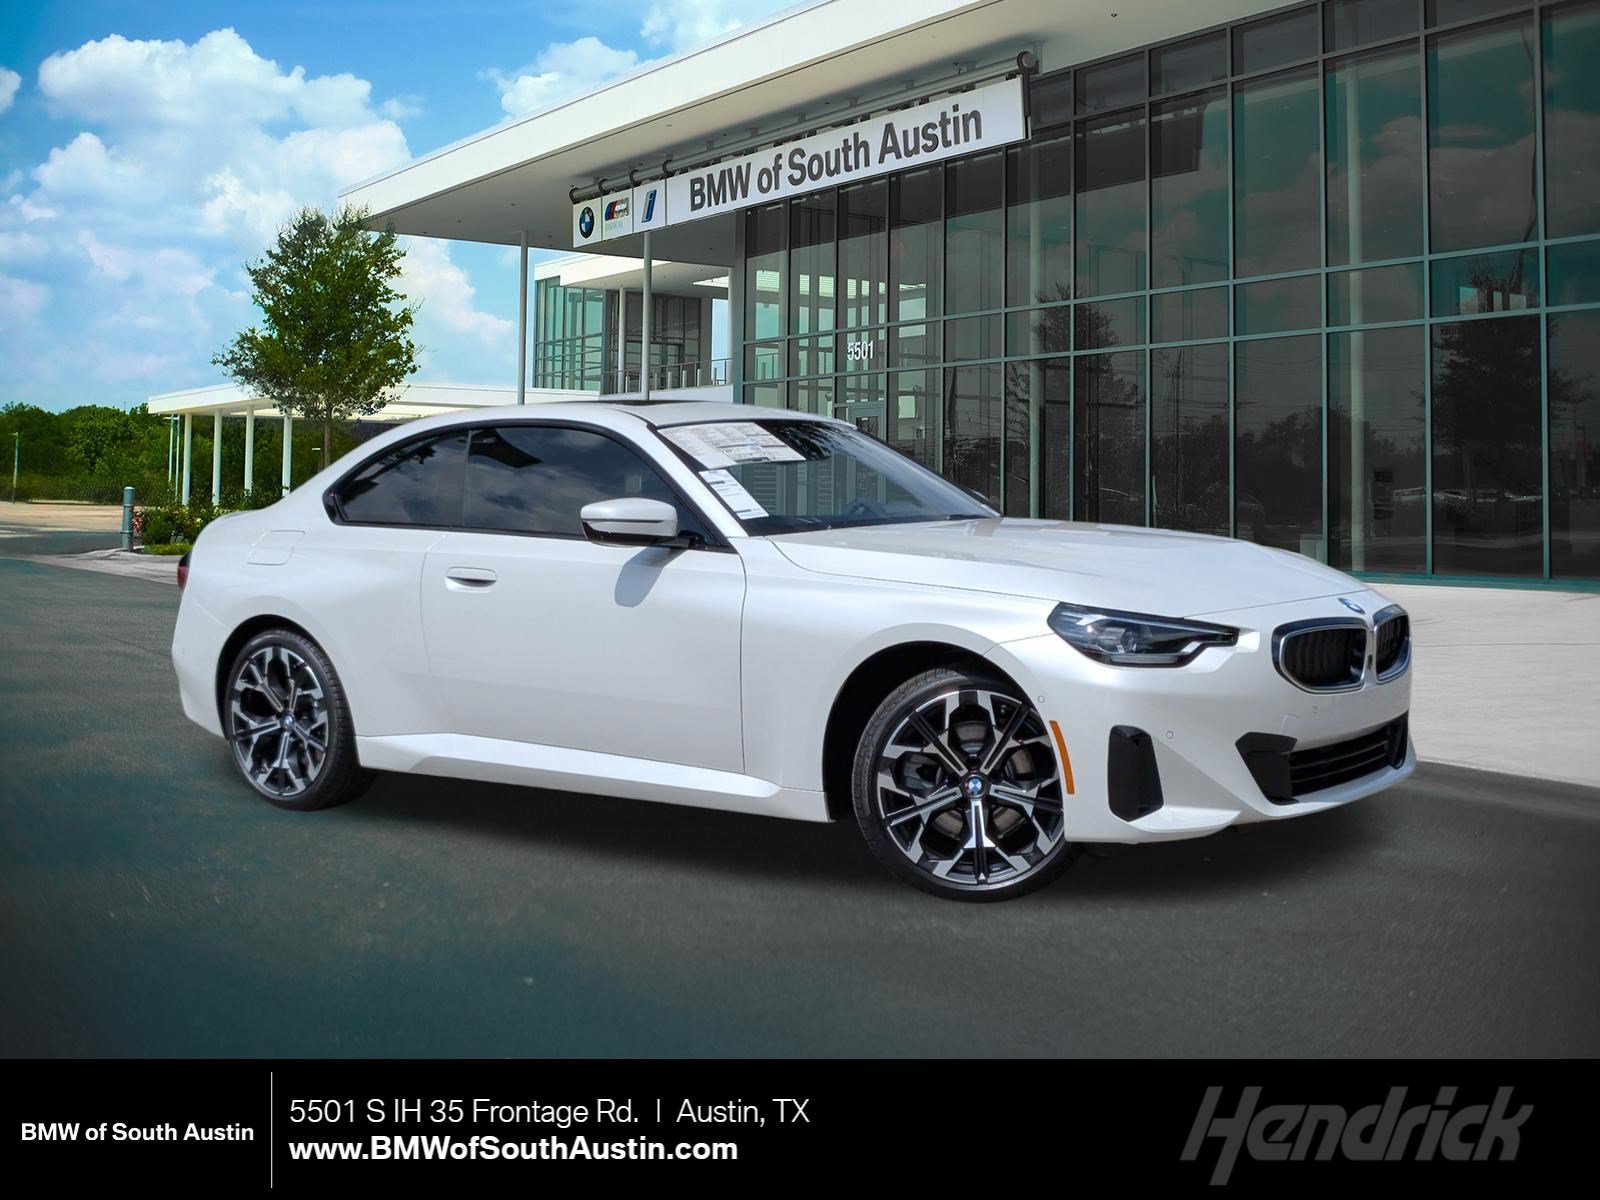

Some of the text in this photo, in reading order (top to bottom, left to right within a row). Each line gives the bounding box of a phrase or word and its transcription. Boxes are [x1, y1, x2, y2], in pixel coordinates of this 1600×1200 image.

[690, 104, 982, 212] BMW of South Austin
[847, 340, 874, 361] 5501
